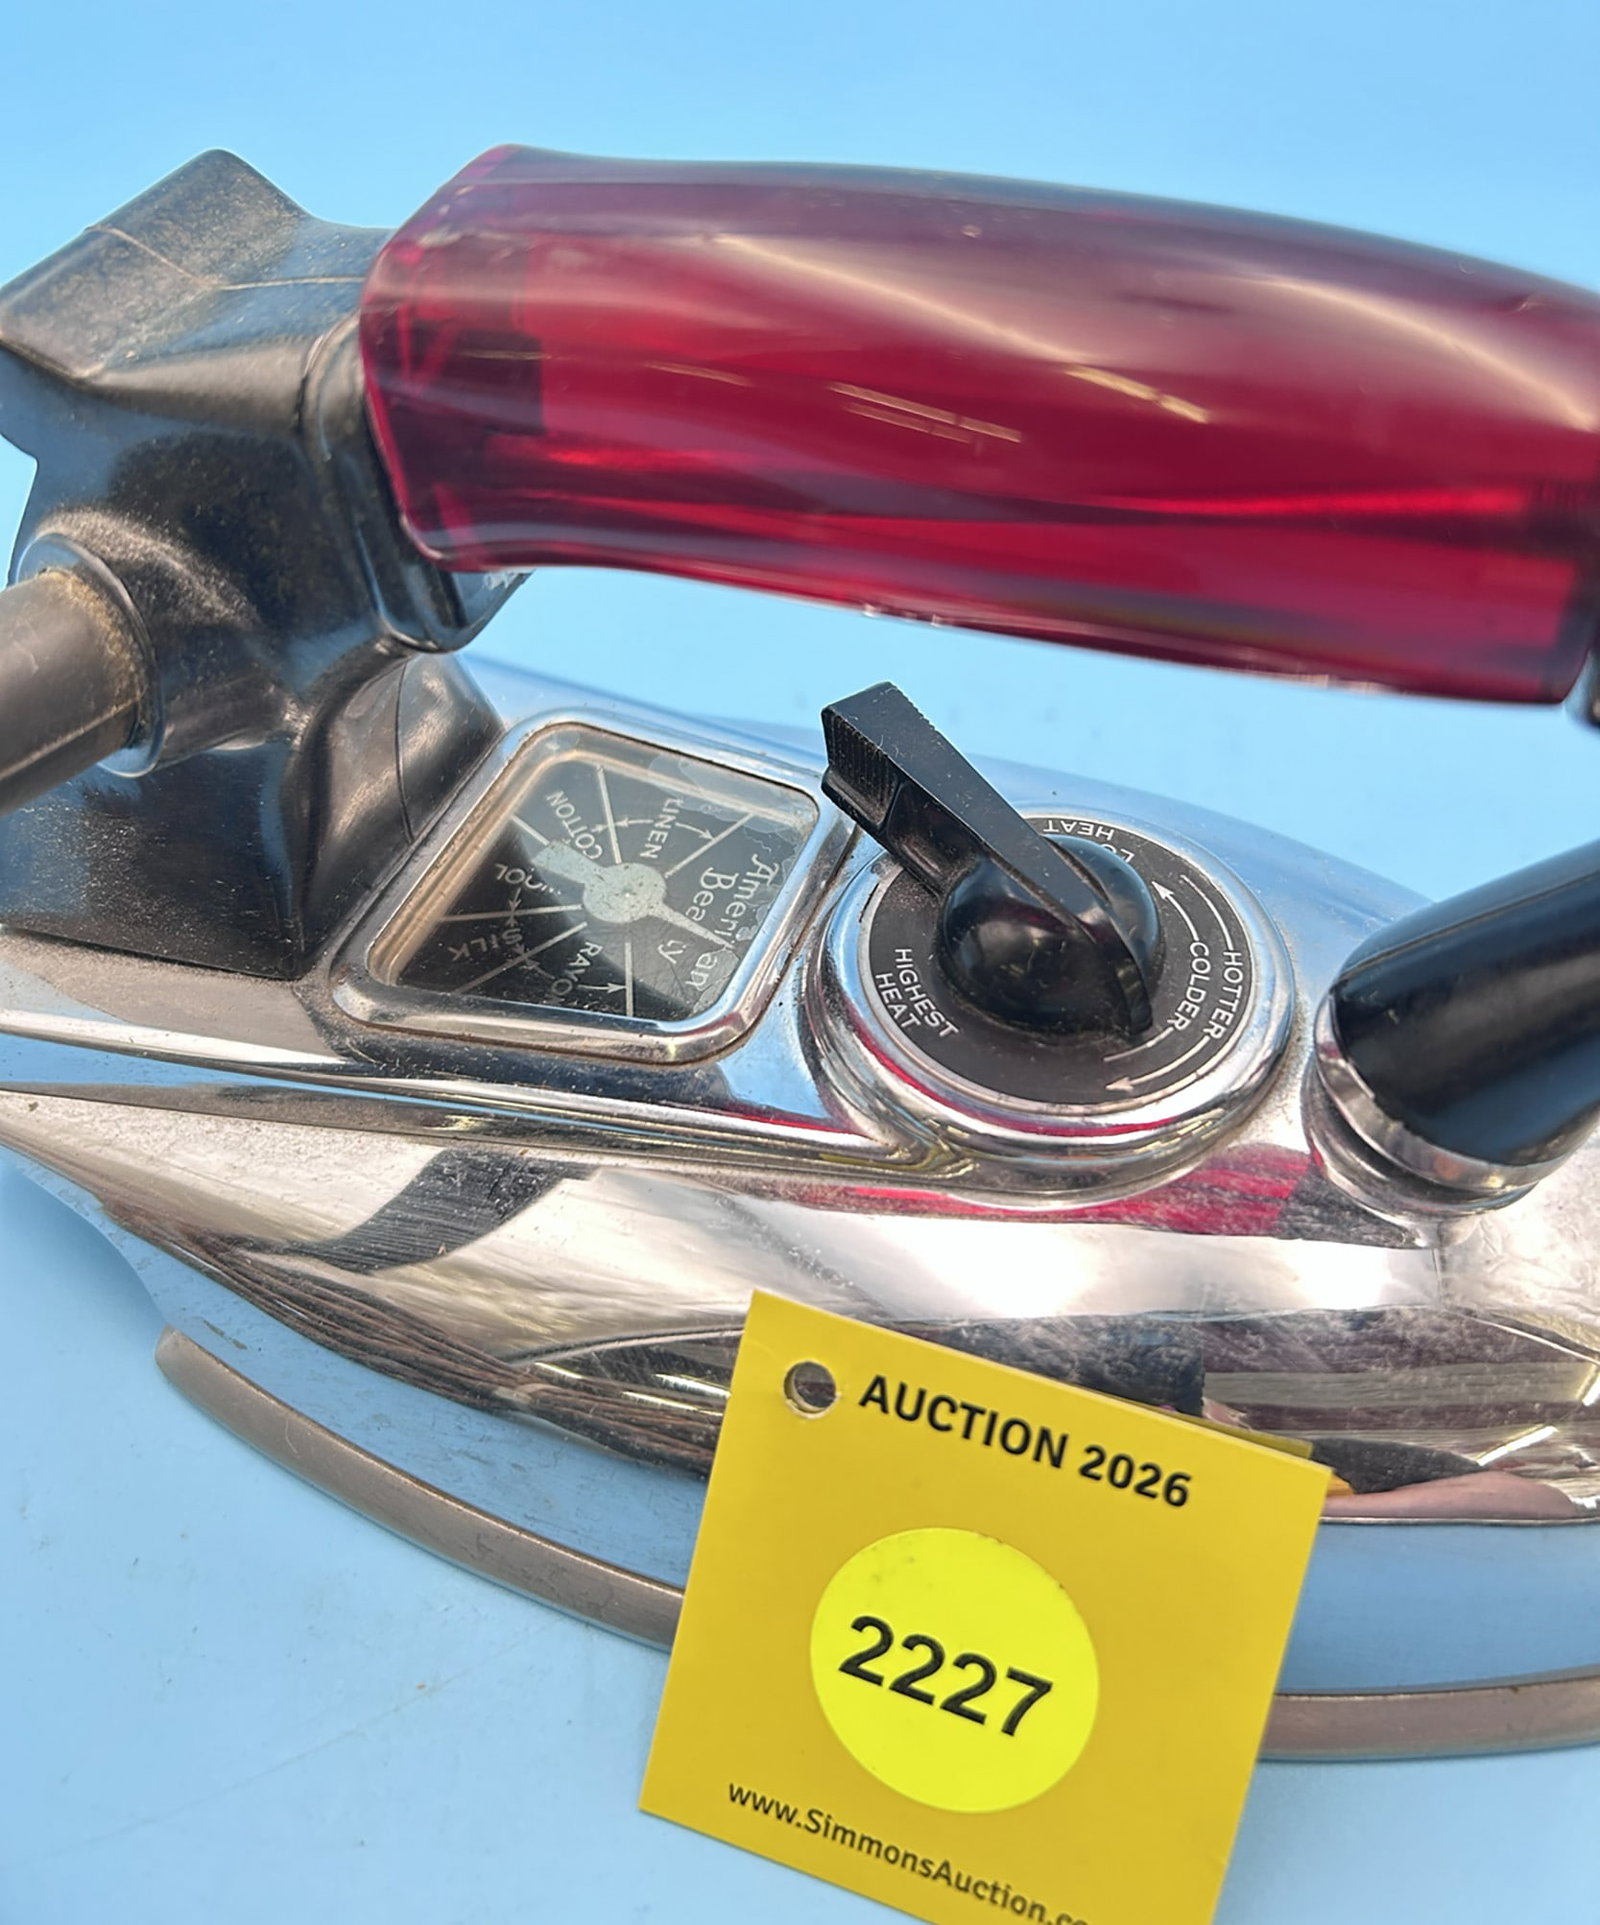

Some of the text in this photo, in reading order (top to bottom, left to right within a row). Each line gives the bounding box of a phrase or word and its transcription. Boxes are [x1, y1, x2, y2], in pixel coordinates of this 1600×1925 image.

[546, 790, 603, 860] COTTON
[640, 797, 682, 859] LINEN
[1043, 820, 1115, 841] HEAT
[495, 863, 562, 895] OOL
[657, 867, 739, 964] Beaty
[447, 928, 523, 961] SILK
[685, 854, 779, 991] Amerian
[549, 942, 603, 1002] RAYO
[875, 973, 921, 1027] HEAT
[895, 949, 959, 1037] HIGHEST
[1167, 942, 1211, 1030] COLDER
[1203, 952, 1244, 1039] HOTTER
[858, 1375, 1192, 1507] AUCTION 2026
[838, 1615, 1053, 1737] 2227
